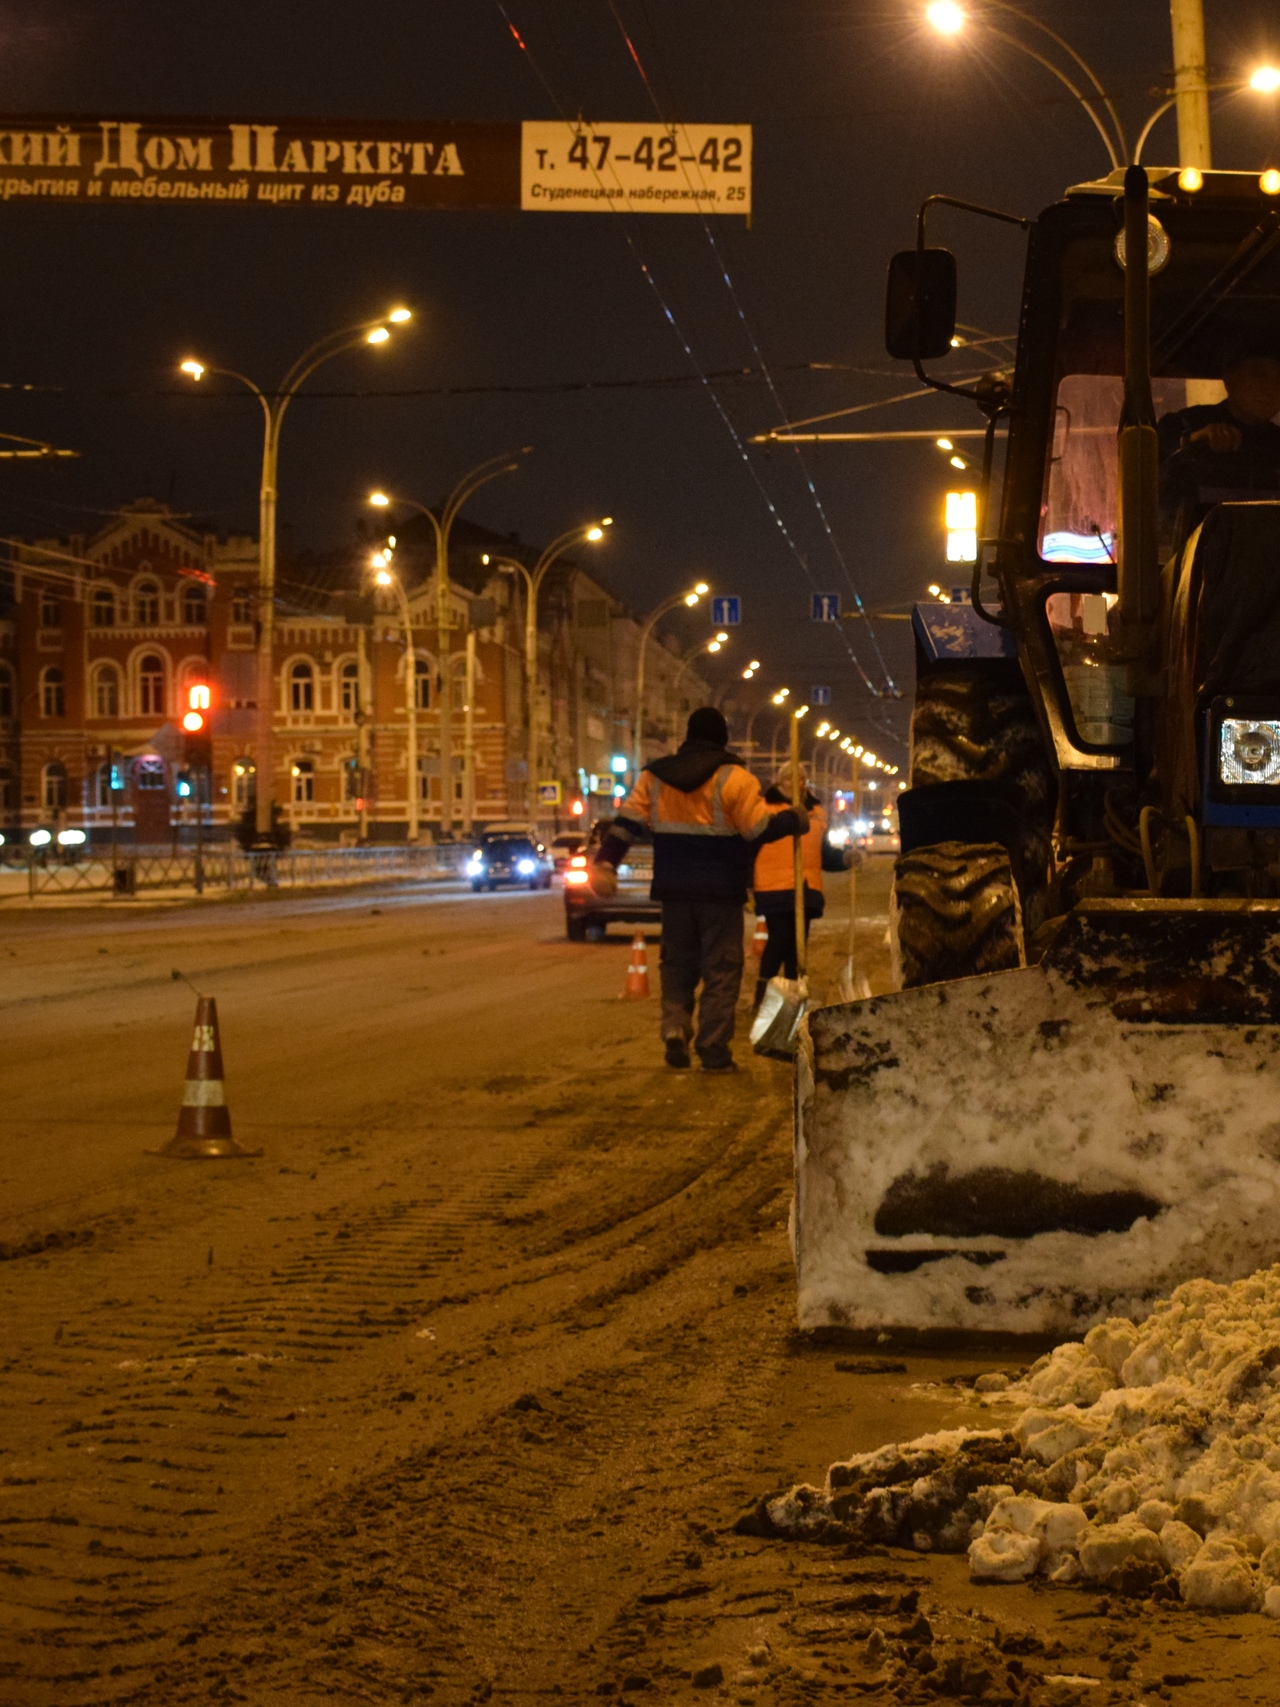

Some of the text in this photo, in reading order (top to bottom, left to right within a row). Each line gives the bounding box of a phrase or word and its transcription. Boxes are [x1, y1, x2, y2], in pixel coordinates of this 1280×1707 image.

[568, 136, 743, 173] 47-42-42
[87, 180, 102, 197] и
[110, 178, 249, 200] мебельный
[257, 182, 305, 203] щит
[311, 184, 341, 202] из
[346, 180, 405, 208] дуба
[531, 183, 625, 202] Студенецкая
[725, 187, 746, 202] 25
